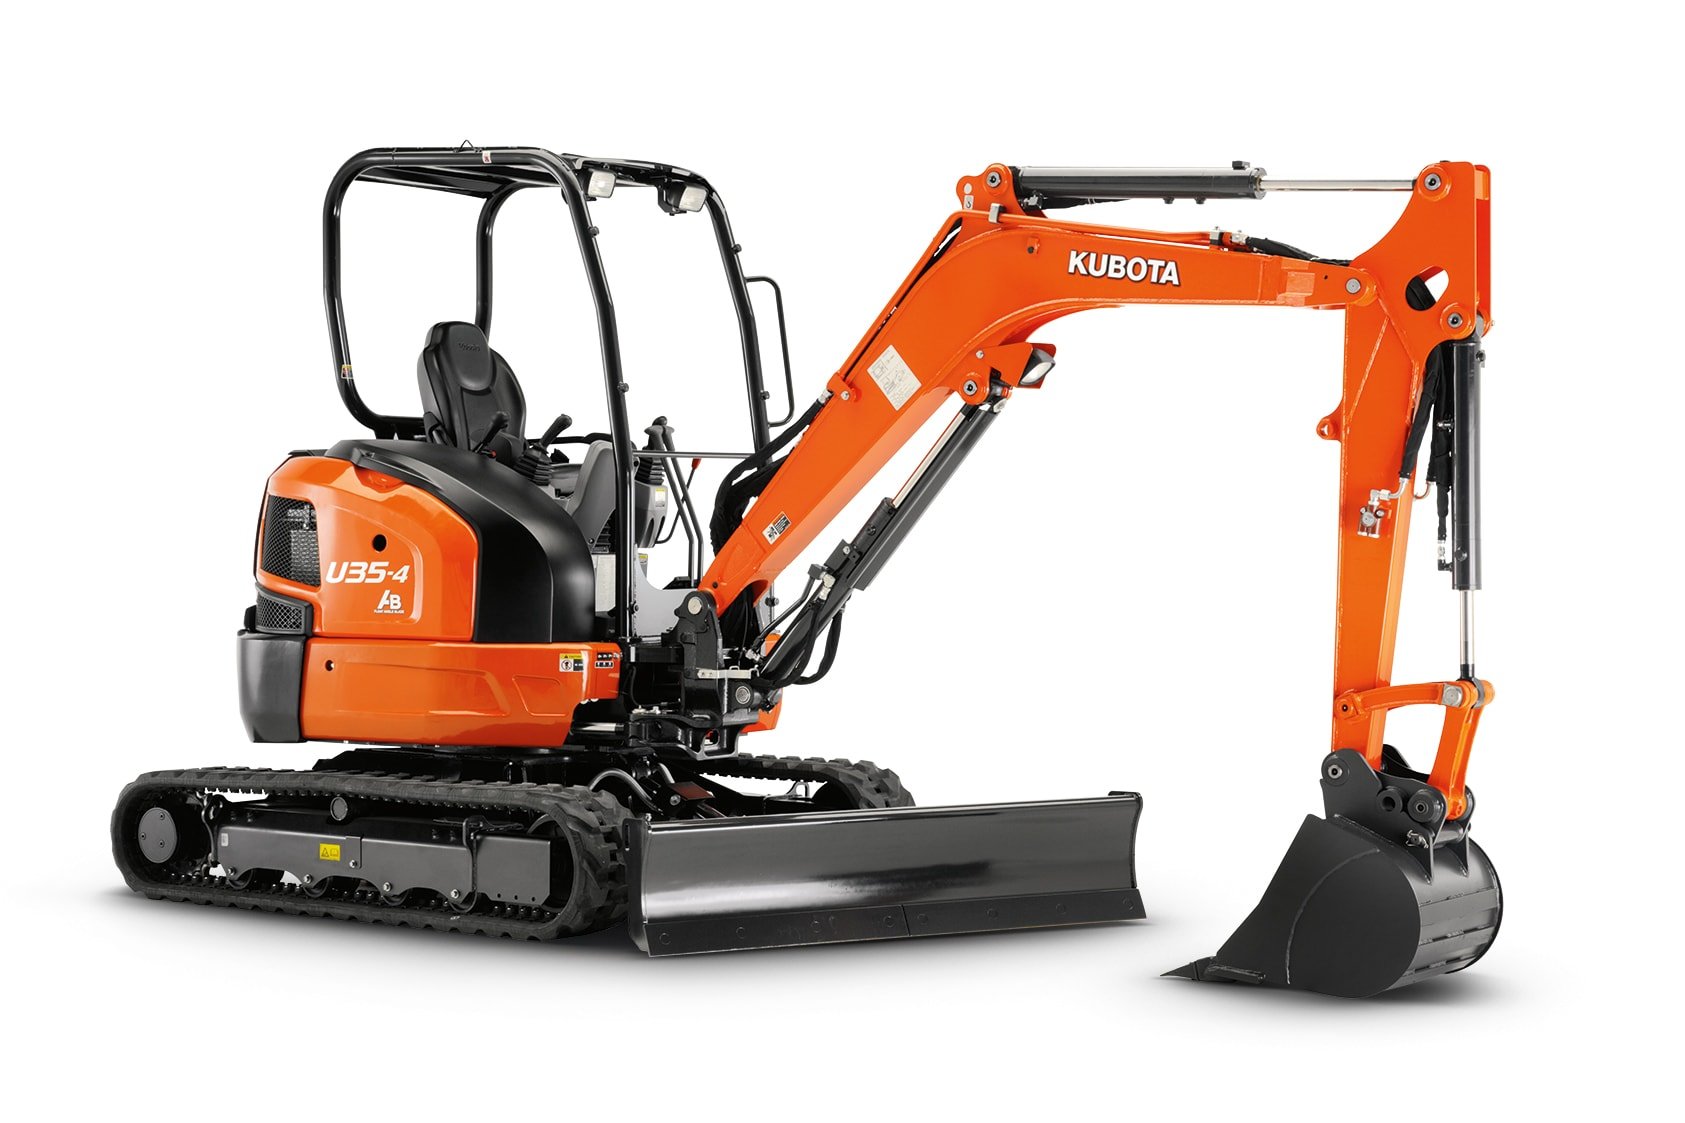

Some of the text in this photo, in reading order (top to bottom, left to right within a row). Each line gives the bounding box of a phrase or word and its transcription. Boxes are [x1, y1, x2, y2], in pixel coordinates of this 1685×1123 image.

[1067, 249, 1180, 286] KUBOTA
[325, 561, 411, 584] U35-4
[377, 589, 402, 610] AB
